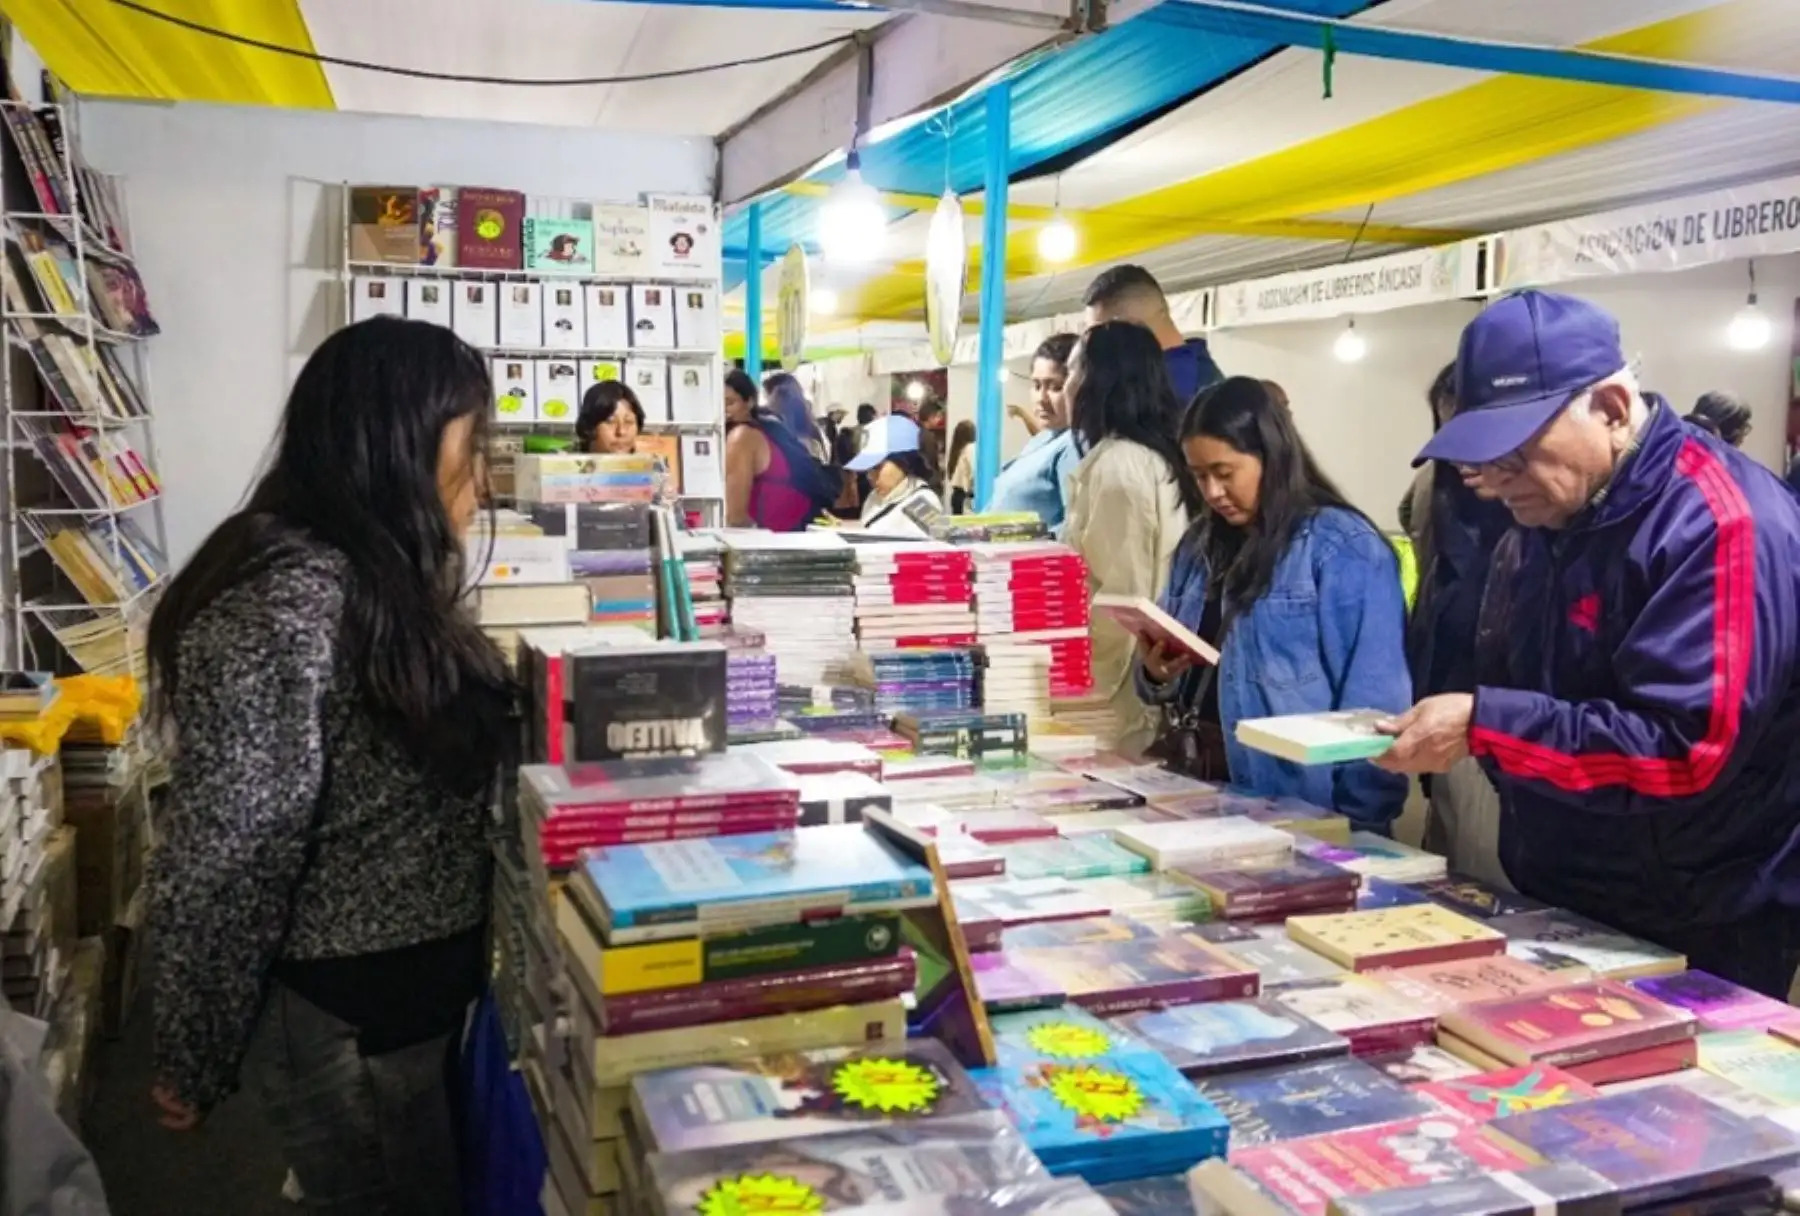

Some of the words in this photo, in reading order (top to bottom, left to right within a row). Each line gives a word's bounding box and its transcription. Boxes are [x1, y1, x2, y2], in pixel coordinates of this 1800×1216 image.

[1682, 213, 1707, 246] DE
[1310, 281, 1325, 302] DE
[1325, 272, 1377, 302] LIBREROS
